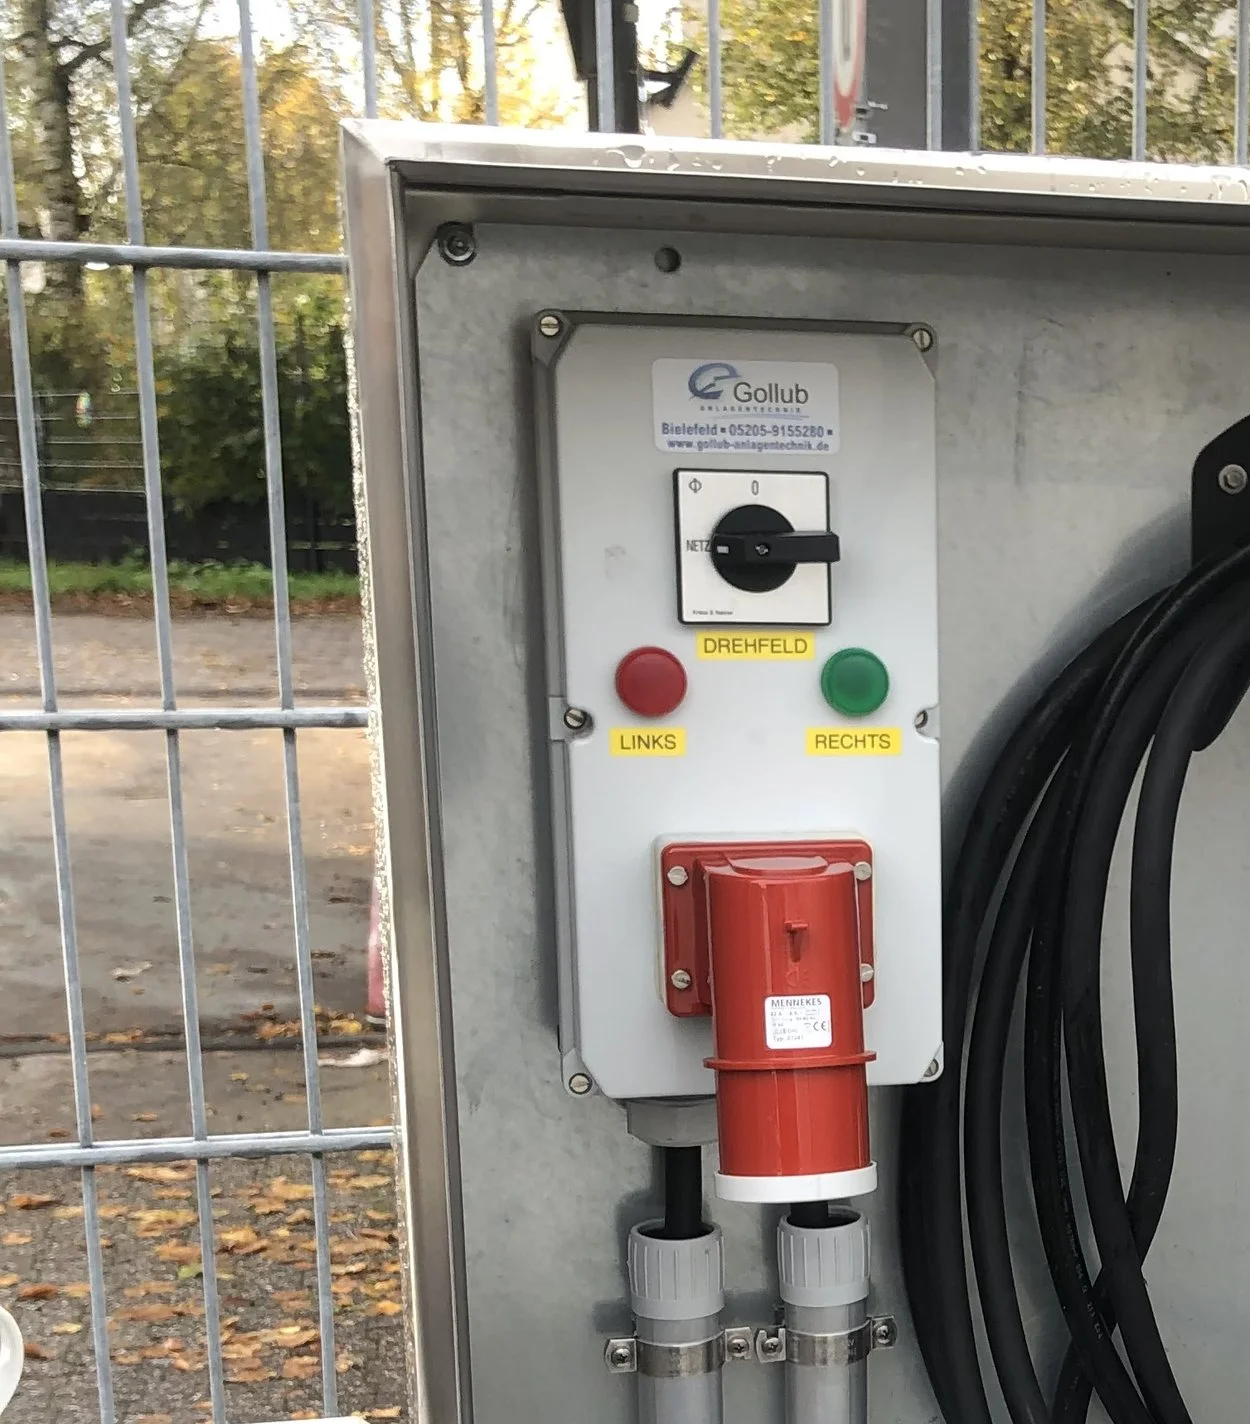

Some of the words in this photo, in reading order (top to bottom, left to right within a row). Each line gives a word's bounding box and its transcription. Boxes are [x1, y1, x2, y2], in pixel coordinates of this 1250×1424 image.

[733, 382, 809, 404] Gollub
[661, 422, 718, 436] Bielefeld
[728, 423, 825, 438] 05205-9155280
[667, 438, 829, 452] www.gollub-anlagentechnik.de
[686, 539, 710, 552] NETZ
[703, 637, 808, 654] DREHFELD
[620, 734, 677, 750] LINKS
[815, 734, 891, 750] RECHTS
[771, 998, 822, 1007] MENNEKES
